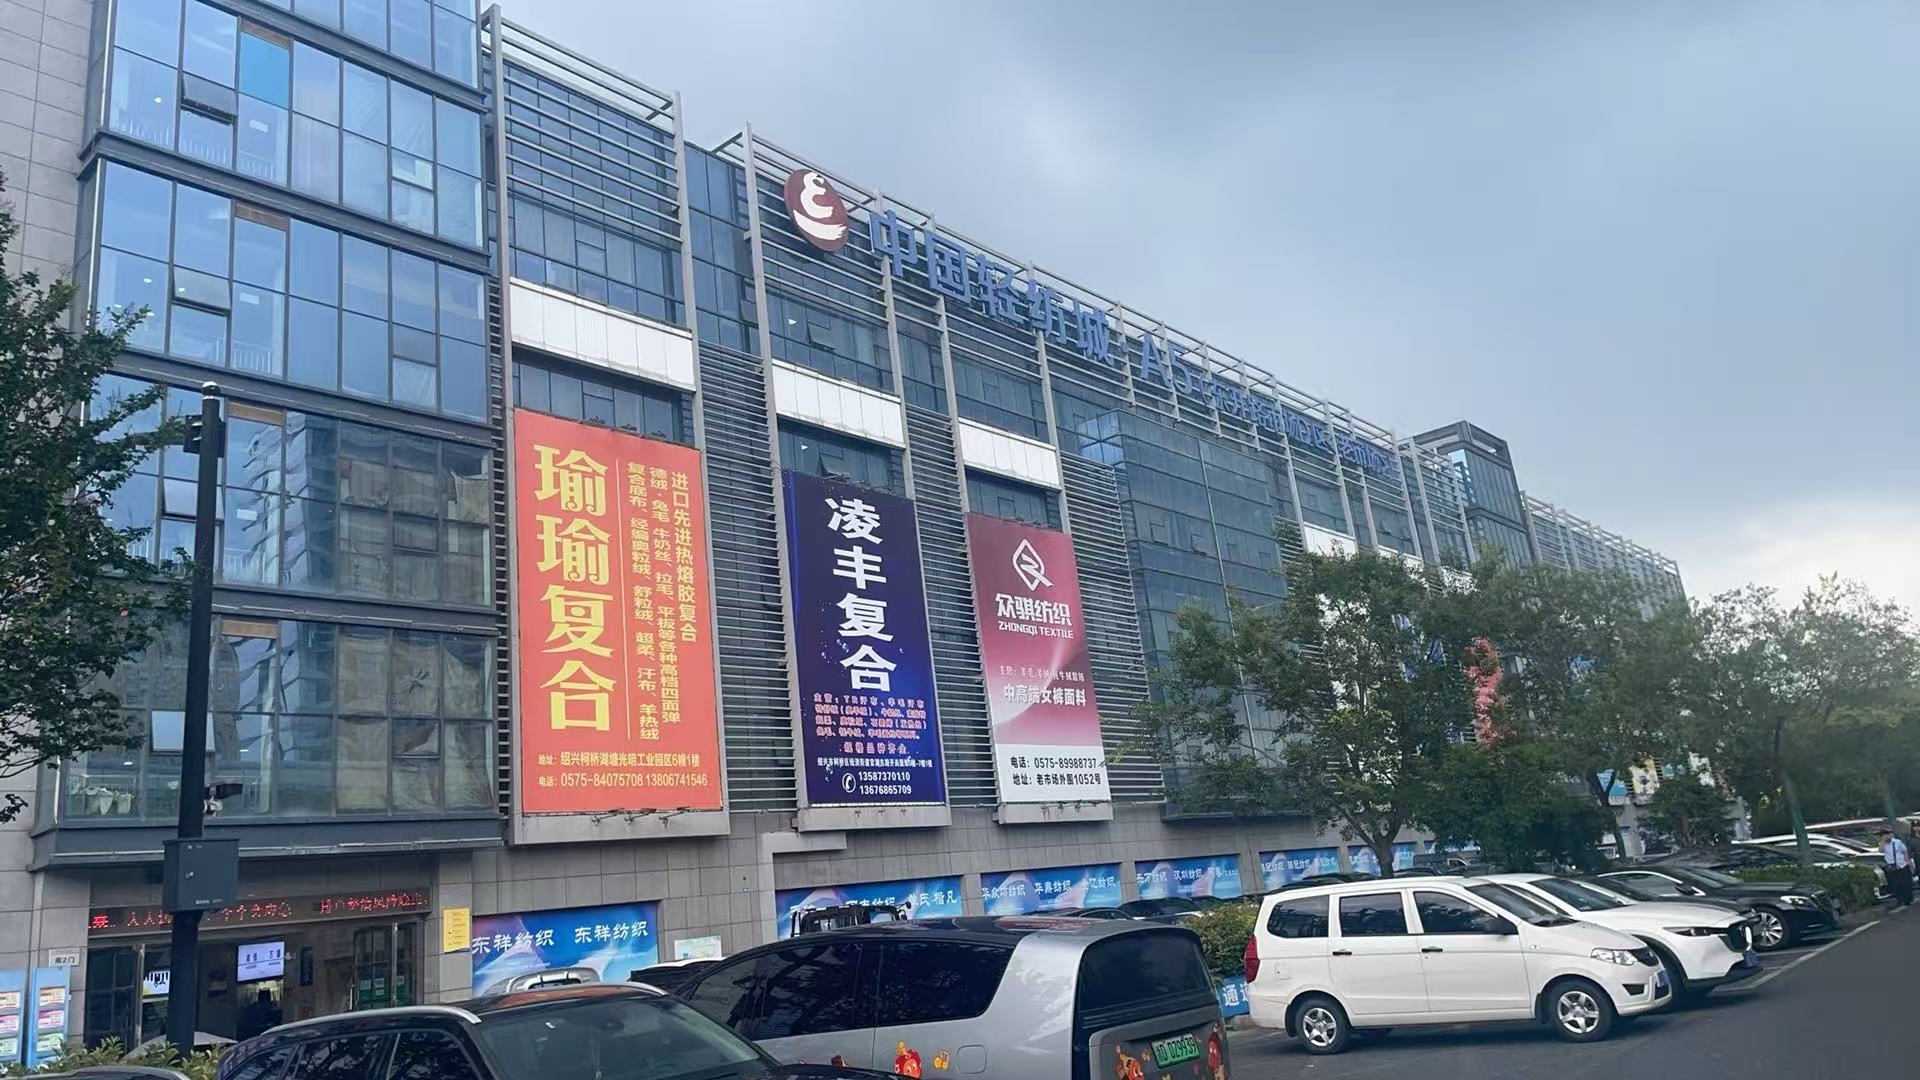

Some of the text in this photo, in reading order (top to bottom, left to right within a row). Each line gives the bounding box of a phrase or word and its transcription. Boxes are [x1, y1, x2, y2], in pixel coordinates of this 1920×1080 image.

[671, 471, 697, 643] 进口先进热熔胶复合
[533, 444, 616, 732] 瑜瑜复合
[824, 498, 897, 692] 凌丰复合
[998, 620, 1074, 639] ZHONGQI TEXTILE
[560, 772, 644, 788] 0575-84075708
[645, 773, 708, 787] 13806741546
[858, 771, 911, 781] 13587370110
[859, 784, 912, 795] 13676865709
[472, 929, 555, 955] 东祥纺织
[574, 921, 649, 944] 东祥纺织
